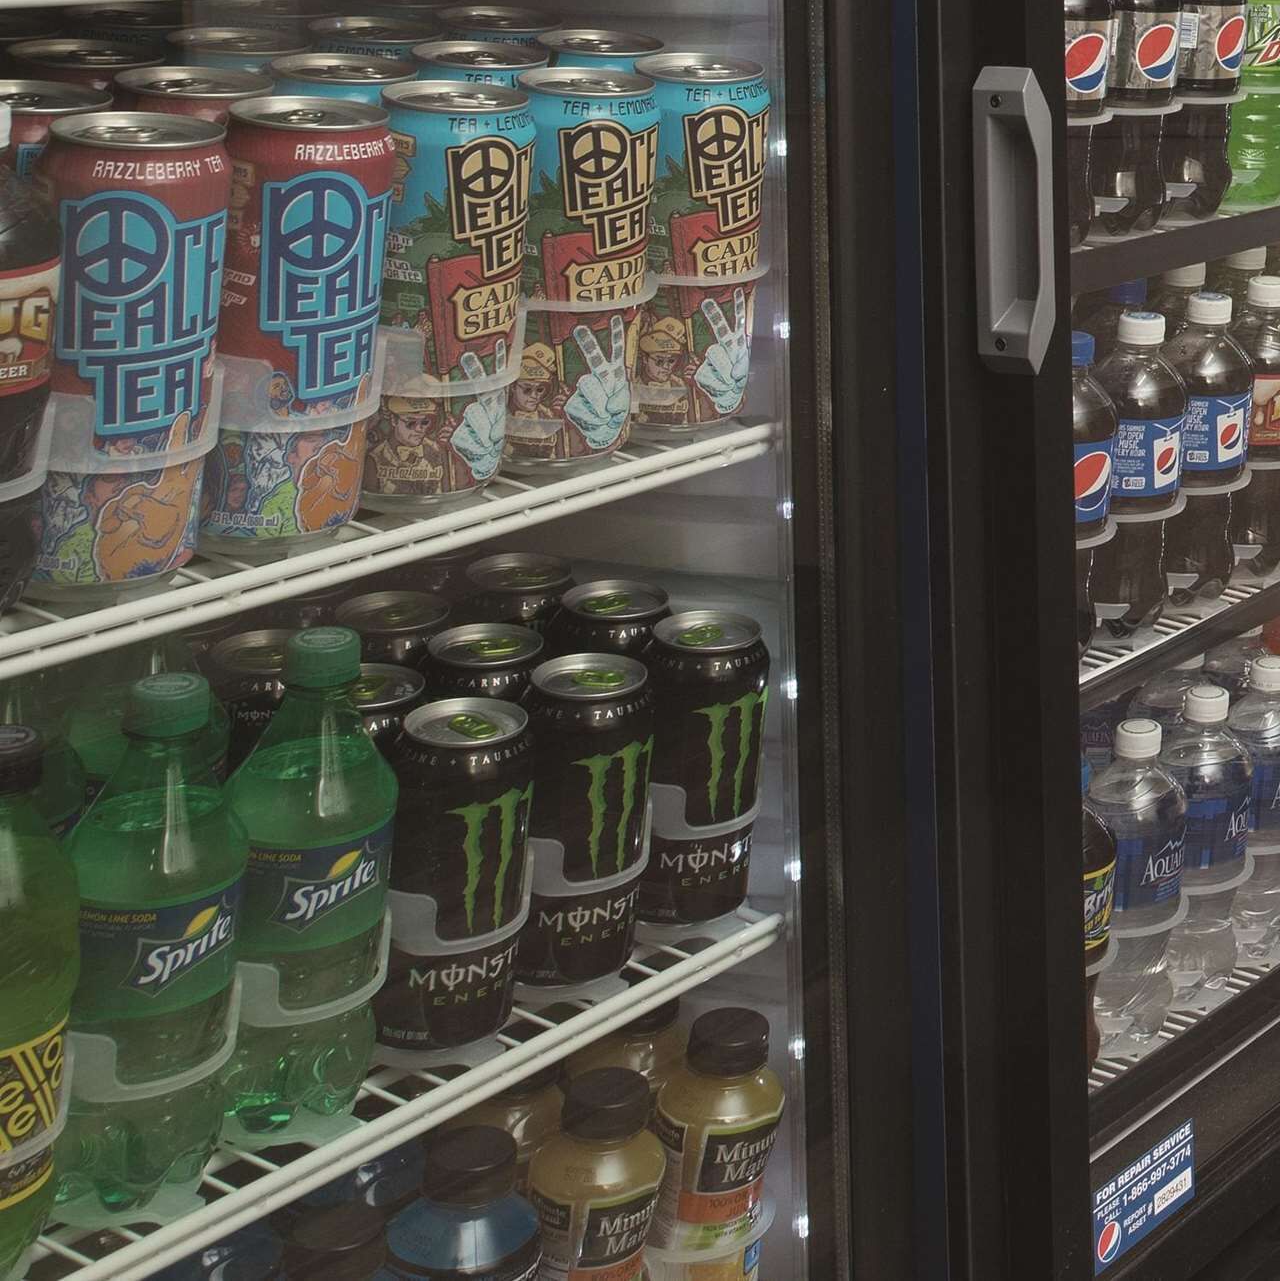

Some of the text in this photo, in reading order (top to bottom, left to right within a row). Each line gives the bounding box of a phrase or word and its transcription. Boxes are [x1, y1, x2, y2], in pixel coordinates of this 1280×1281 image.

[93, 154, 225, 181] RAZZLEBERRY TEA
[290, 315, 373, 394] TEA
[95, 351, 200, 432] TEA
[285, 856, 377, 923] Sprite
[137, 912, 234, 988] Sprite
[1096, 1123, 1191, 1206] FOR REPAIR SERVICE
[1122, 1144, 1191, 1207] 1-866-997-3774
[1097, 1198, 1121, 1220] PLEASE
[1123, 1205, 1147, 1228] REPORT
[1128, 1215, 1147, 1235] ASSET
